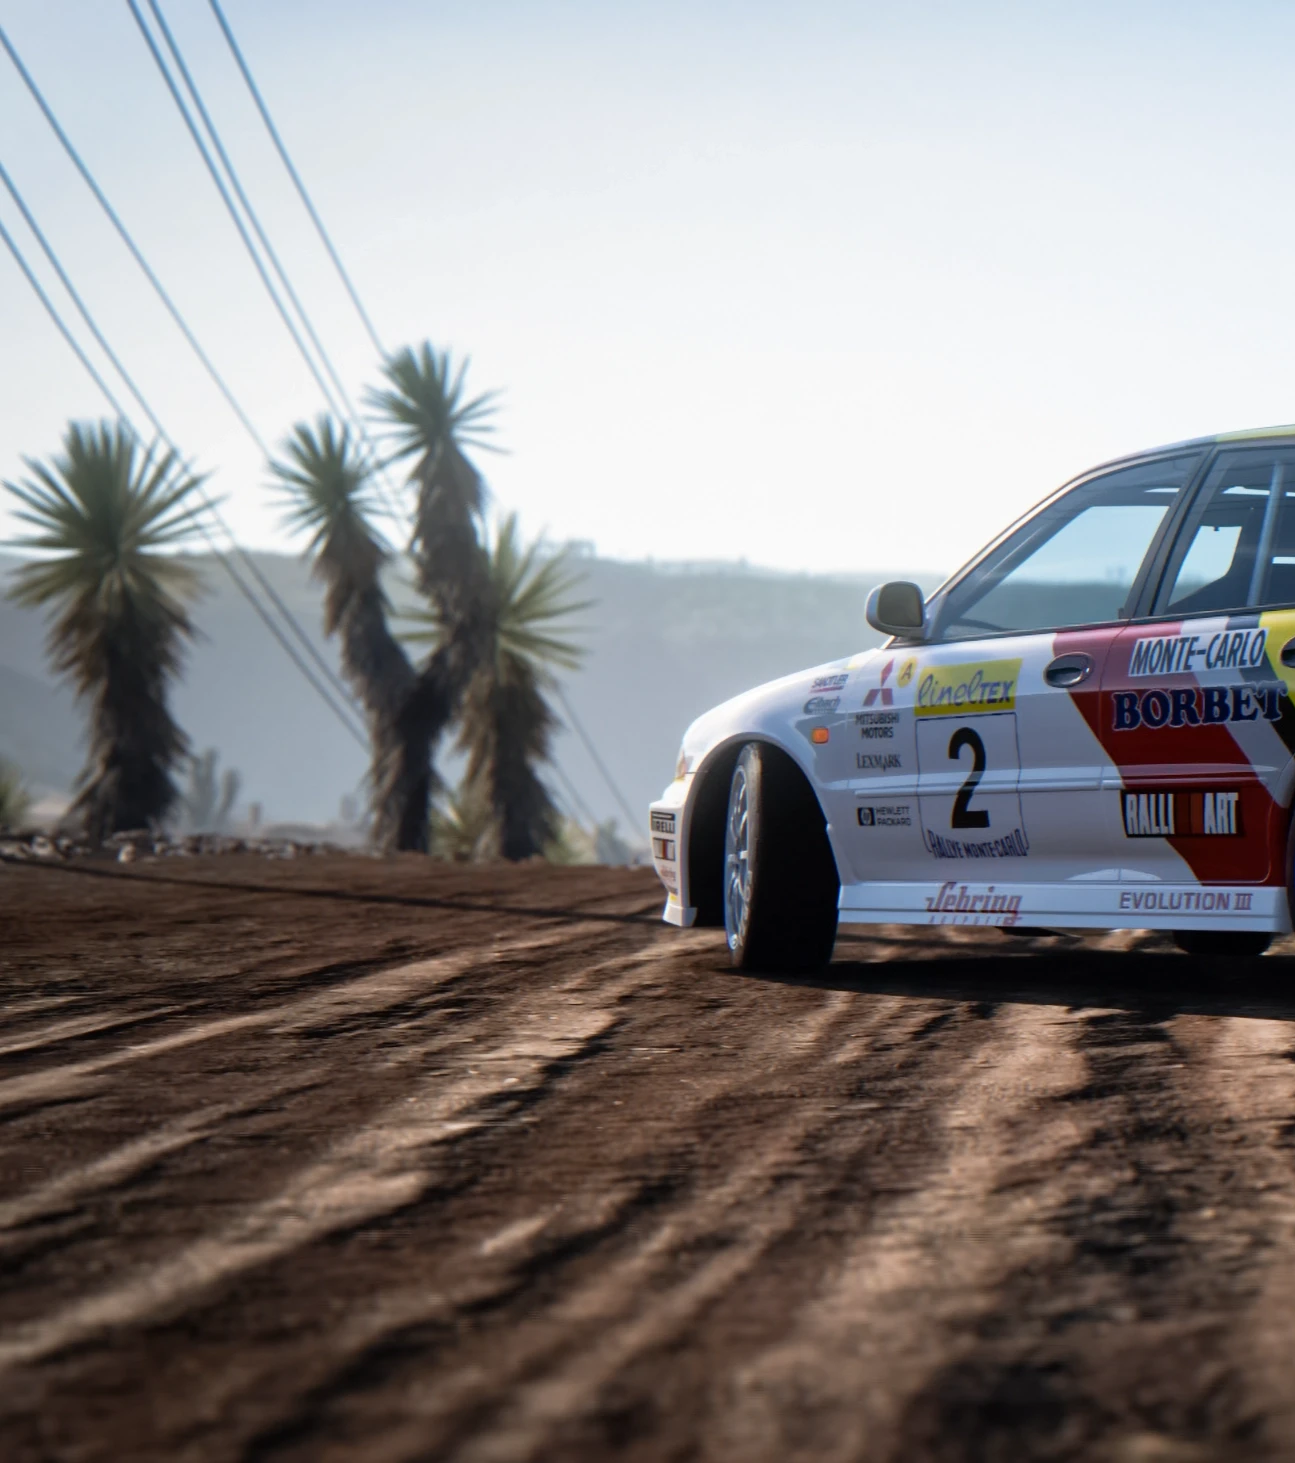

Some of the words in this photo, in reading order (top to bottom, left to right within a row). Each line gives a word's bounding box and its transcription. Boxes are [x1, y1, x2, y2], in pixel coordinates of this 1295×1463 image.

[1131, 629, 1266, 676] MONTE-CARLO
[900, 663, 913, 681] A
[1112, 680, 1288, 731] BORBET
[855, 713, 899, 726] MITSUBISHI
[860, 726, 894, 739] MOTORS
[948, 726, 991, 829] 2
[876, 806, 910, 815] HEWLETT
[651, 811, 675, 833] PRELLI
[877, 818, 912, 826] PACKARD
[927, 829, 964, 859] RALLYE
[963, 828, 1028, 859] MONTE-CARLO
[1119, 892, 1230, 911] EVOLUTION
